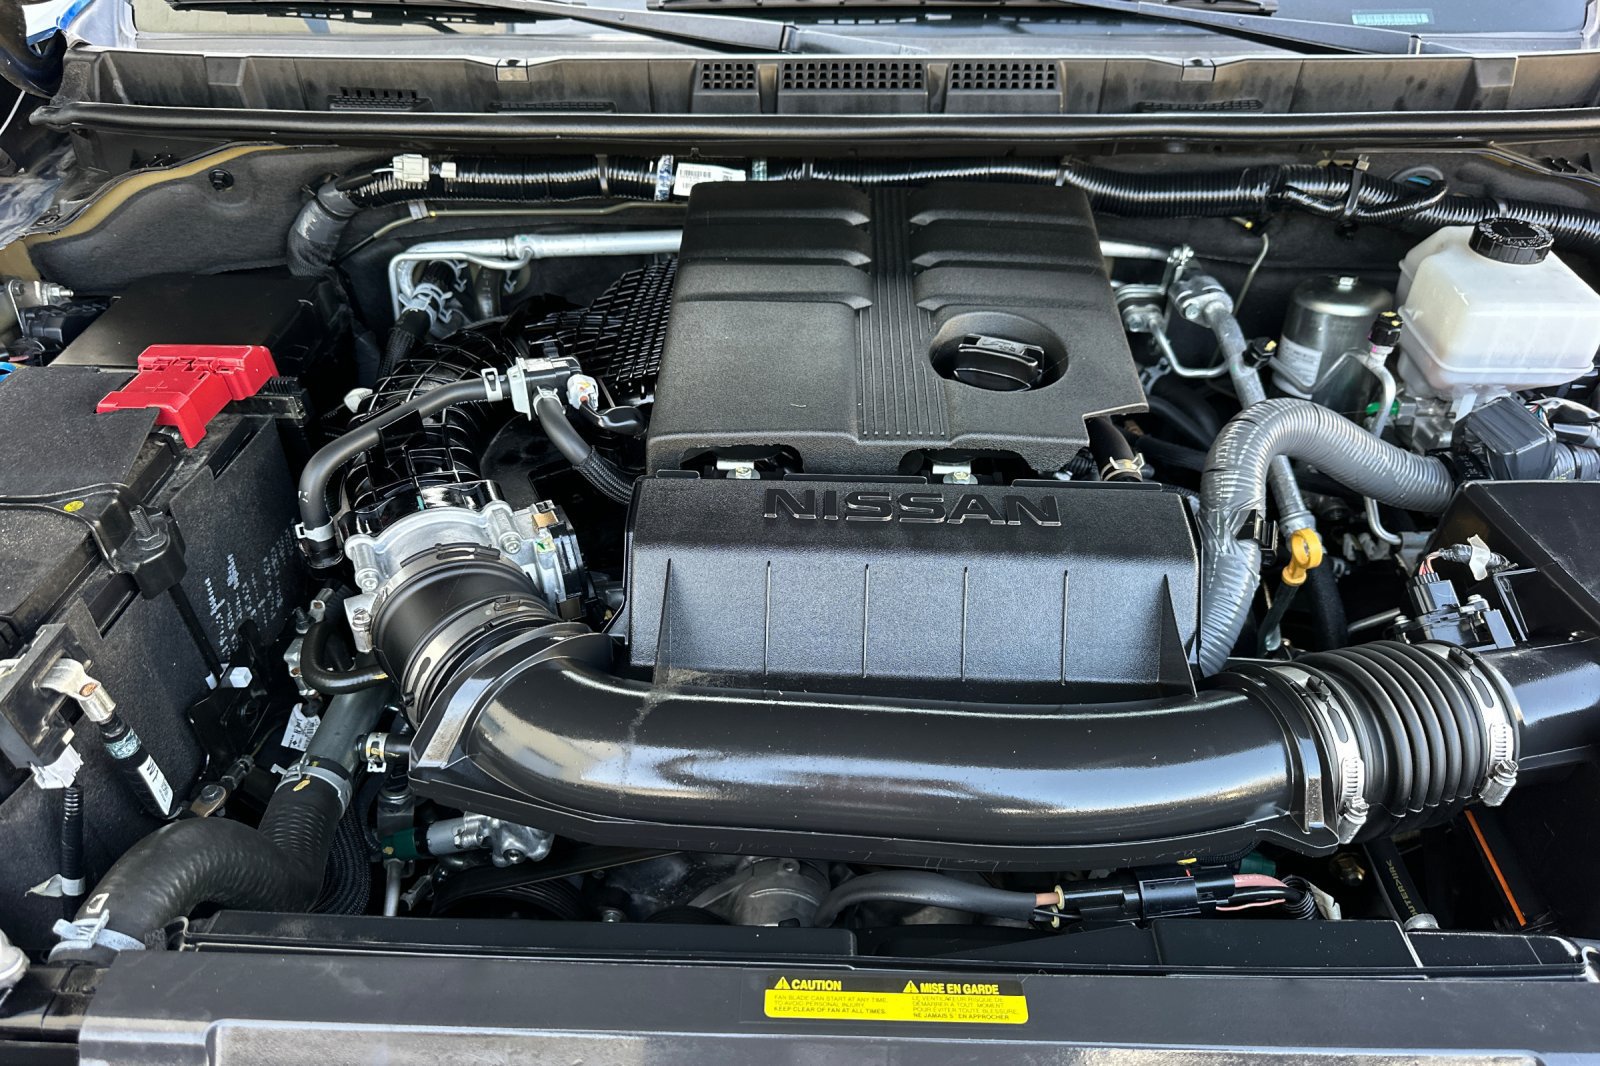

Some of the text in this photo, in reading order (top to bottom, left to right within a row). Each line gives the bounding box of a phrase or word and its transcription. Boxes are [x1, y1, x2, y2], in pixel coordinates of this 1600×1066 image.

[763, 488, 1062, 527] NISSAN
[791, 979, 842, 990] CAUTION
[920, 982, 1000, 994] MISE EN GARDE
